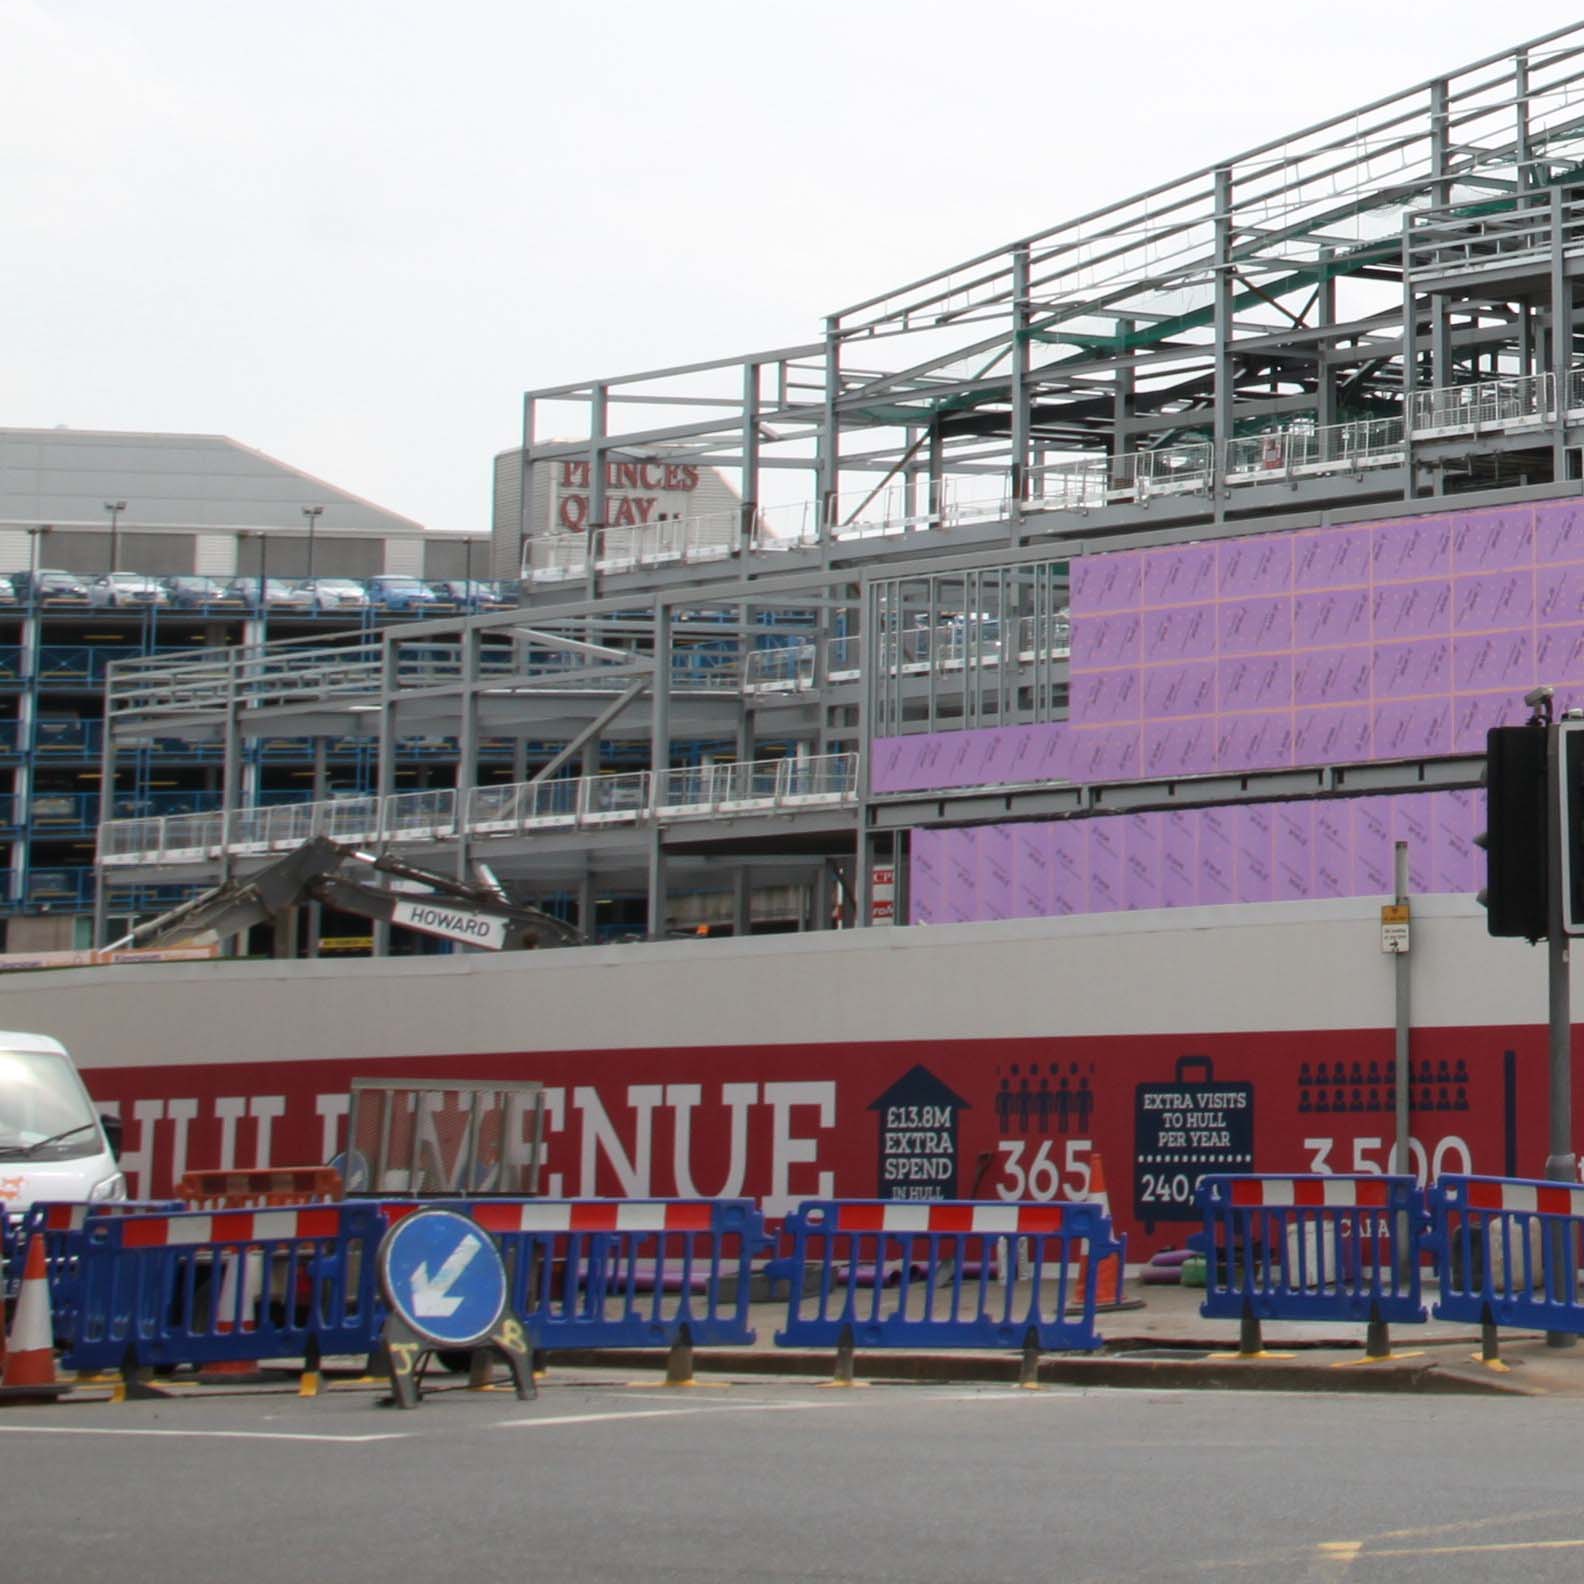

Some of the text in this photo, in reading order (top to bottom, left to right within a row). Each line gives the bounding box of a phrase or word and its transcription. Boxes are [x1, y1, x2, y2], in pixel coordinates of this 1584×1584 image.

[410, 907, 490, 937] HOWARD
[1143, 1092, 1247, 1109] EXTRA VISITS
[887, 1106, 952, 1128] £13.8M
[1162, 1112, 1226, 1128] TO HULL
[884, 1132, 953, 1154] EXTRA
[1158, 1131, 1231, 1147] PER YEAR
[884, 1158, 952, 1180] SPEND
[996, 1140, 1092, 1201] 365
